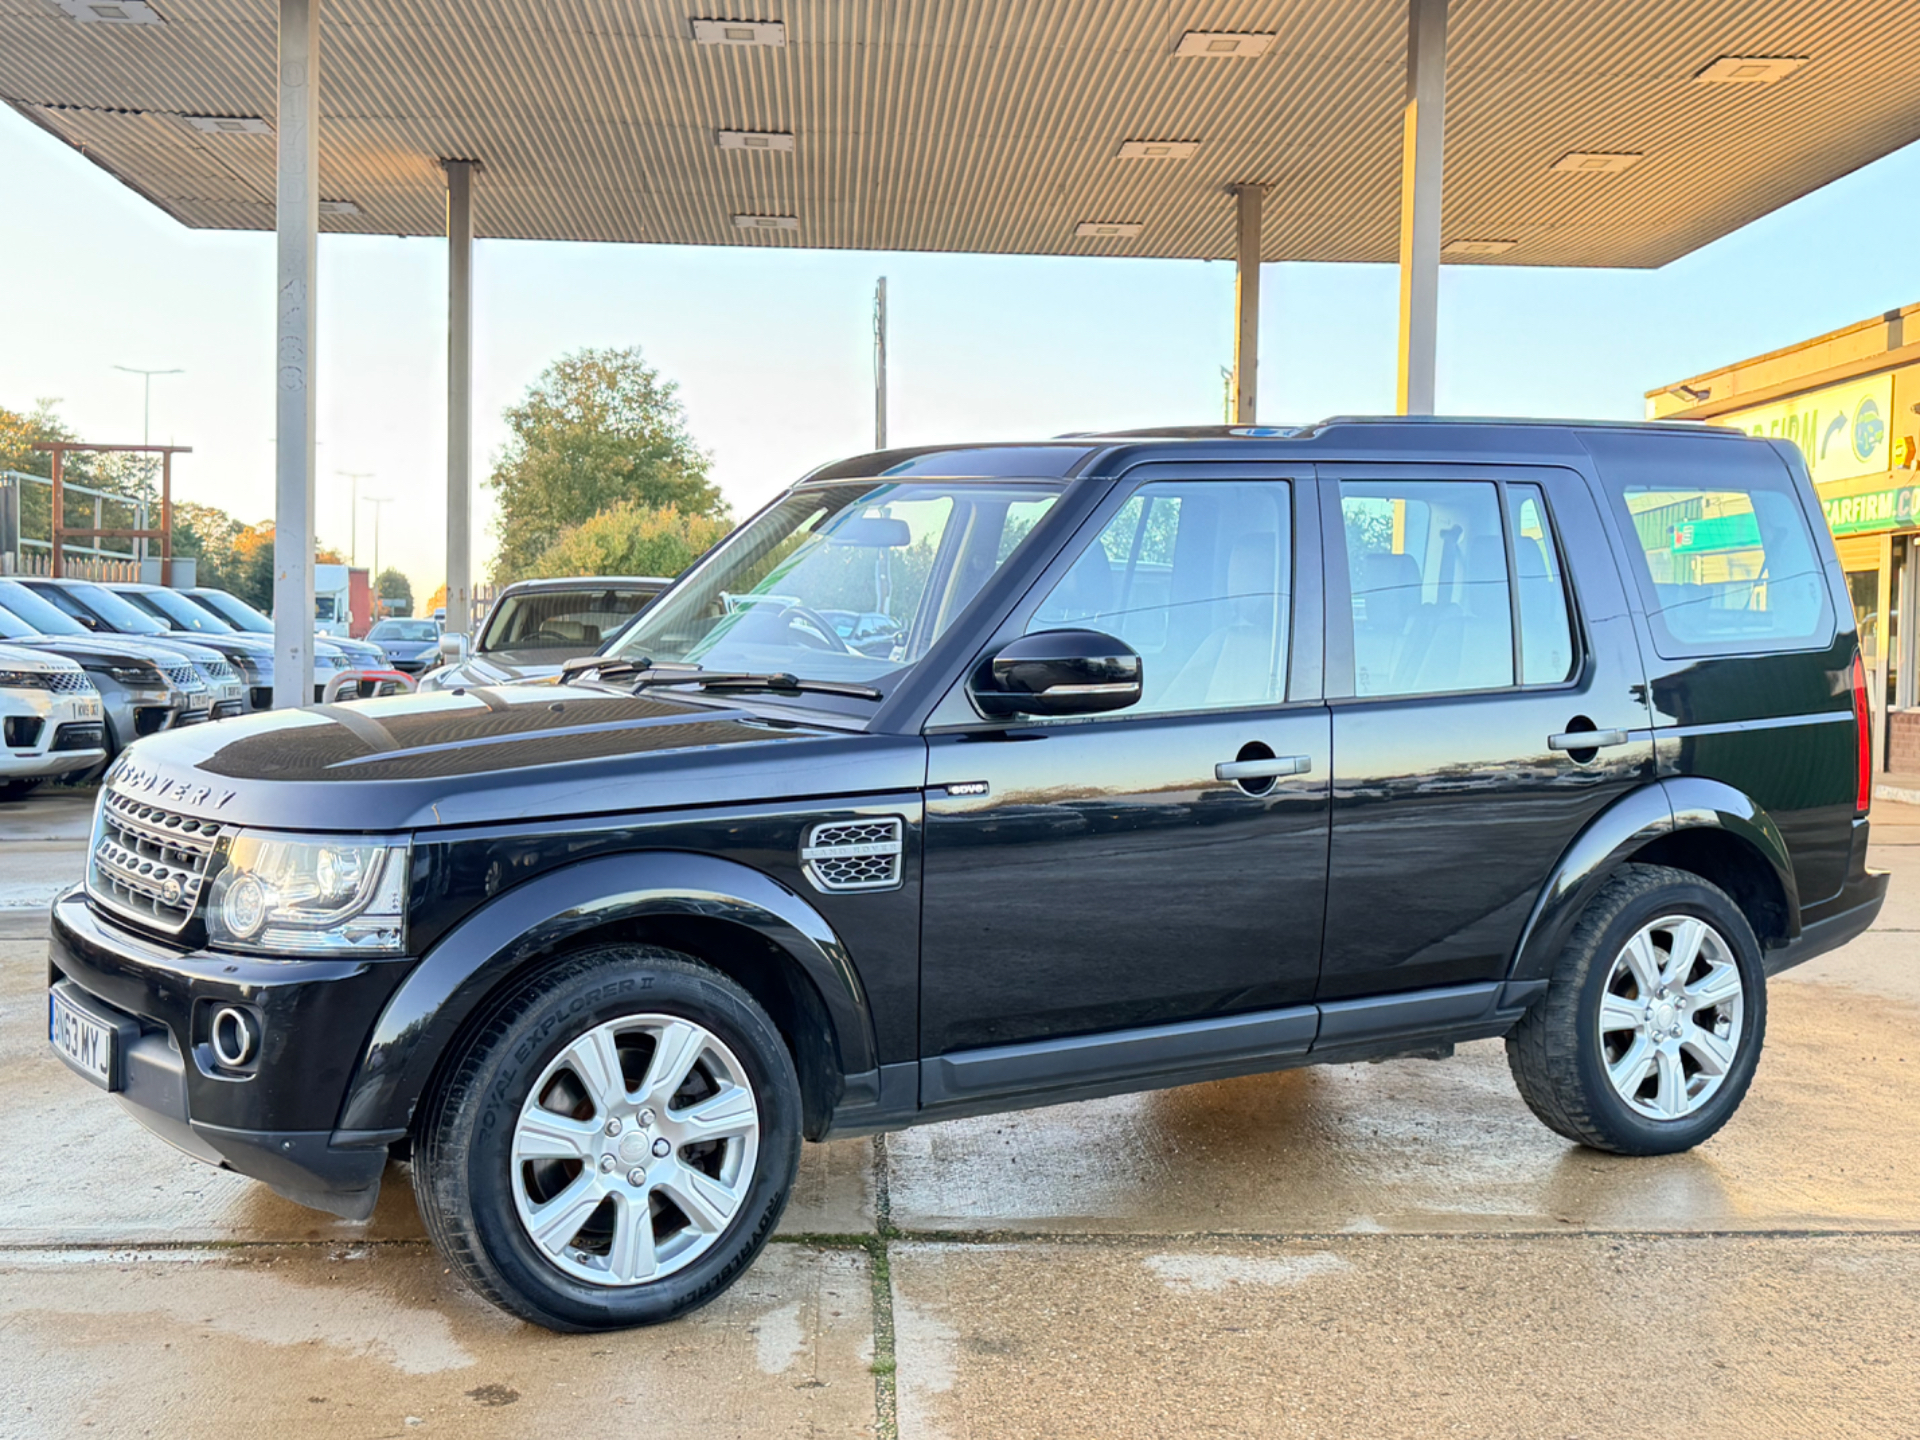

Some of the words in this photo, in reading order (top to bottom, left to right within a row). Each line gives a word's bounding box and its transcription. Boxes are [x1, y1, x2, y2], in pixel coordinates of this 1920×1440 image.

[810, 848, 848, 857] LAND
[853, 843, 897, 854] ROVER
[478, 1068, 518, 1147] ROYAL
[514, 978, 636, 1065] EXPLORER
